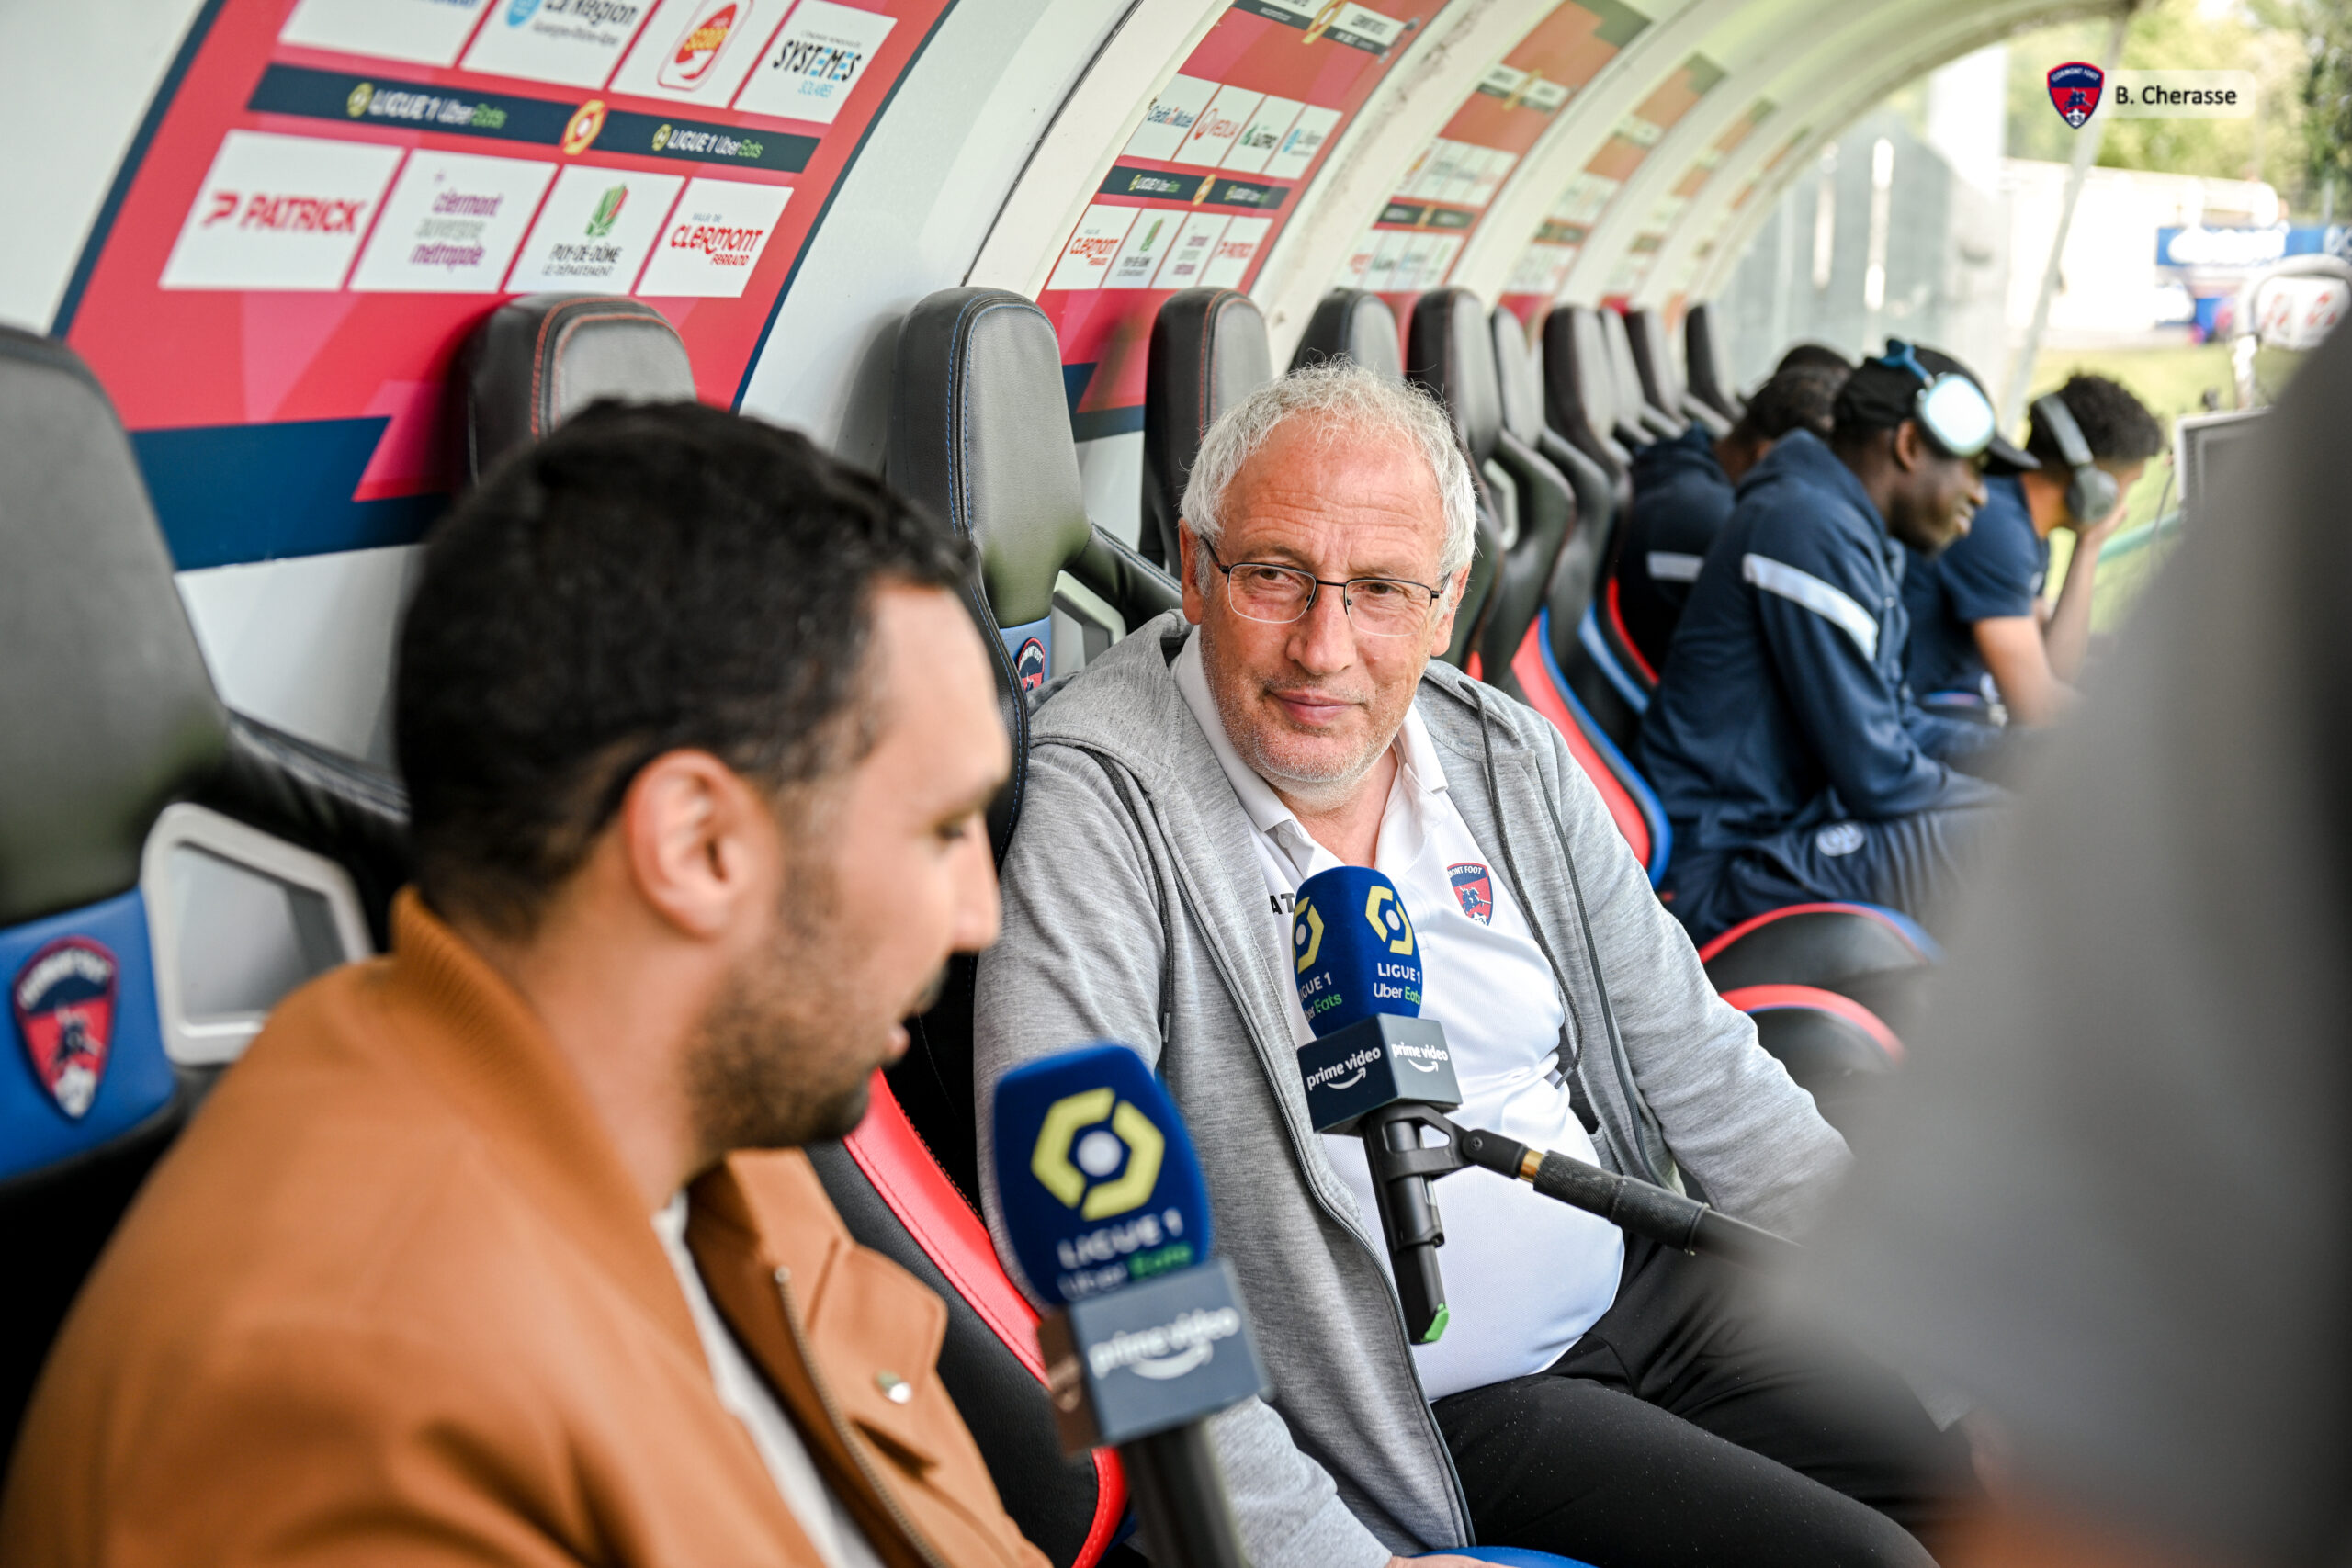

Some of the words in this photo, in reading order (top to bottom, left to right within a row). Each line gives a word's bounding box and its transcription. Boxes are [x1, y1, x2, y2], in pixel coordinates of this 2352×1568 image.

[368, 89, 430, 120] LIGUE
[667, 129, 710, 152] LIGUE
[706, 134, 718, 153] 1
[239, 194, 368, 235] PATRICK
[432, 186, 503, 217] clermont
[1448, 866, 1463, 876] MONT
[1464, 866, 1483, 874] FOOT
[1269, 892, 1295, 915] AT
[1298, 976, 1323, 1002] IGUE
[1324, 971, 1332, 986] 1
[1377, 962, 1416, 982] LIGUE
[1416, 971, 1421, 984] 1
[1305, 1006, 1316, 1022] ber
[1314, 993, 1342, 1014] Eats
[1374, 982, 1403, 998] Uber
[1404, 986, 1421, 1006] Eats
[1391, 1041, 1421, 1059] prime
[1420, 1044, 1449, 1062] video
[1306, 1062, 1345, 1091] prime
[1345, 1047, 1382, 1071] video
[1058, 1214, 1162, 1269] LIGUE
[1162, 1207, 1183, 1237] 1
[1088, 1330, 1170, 1379] prime
[1165, 1307, 1240, 1350] video
